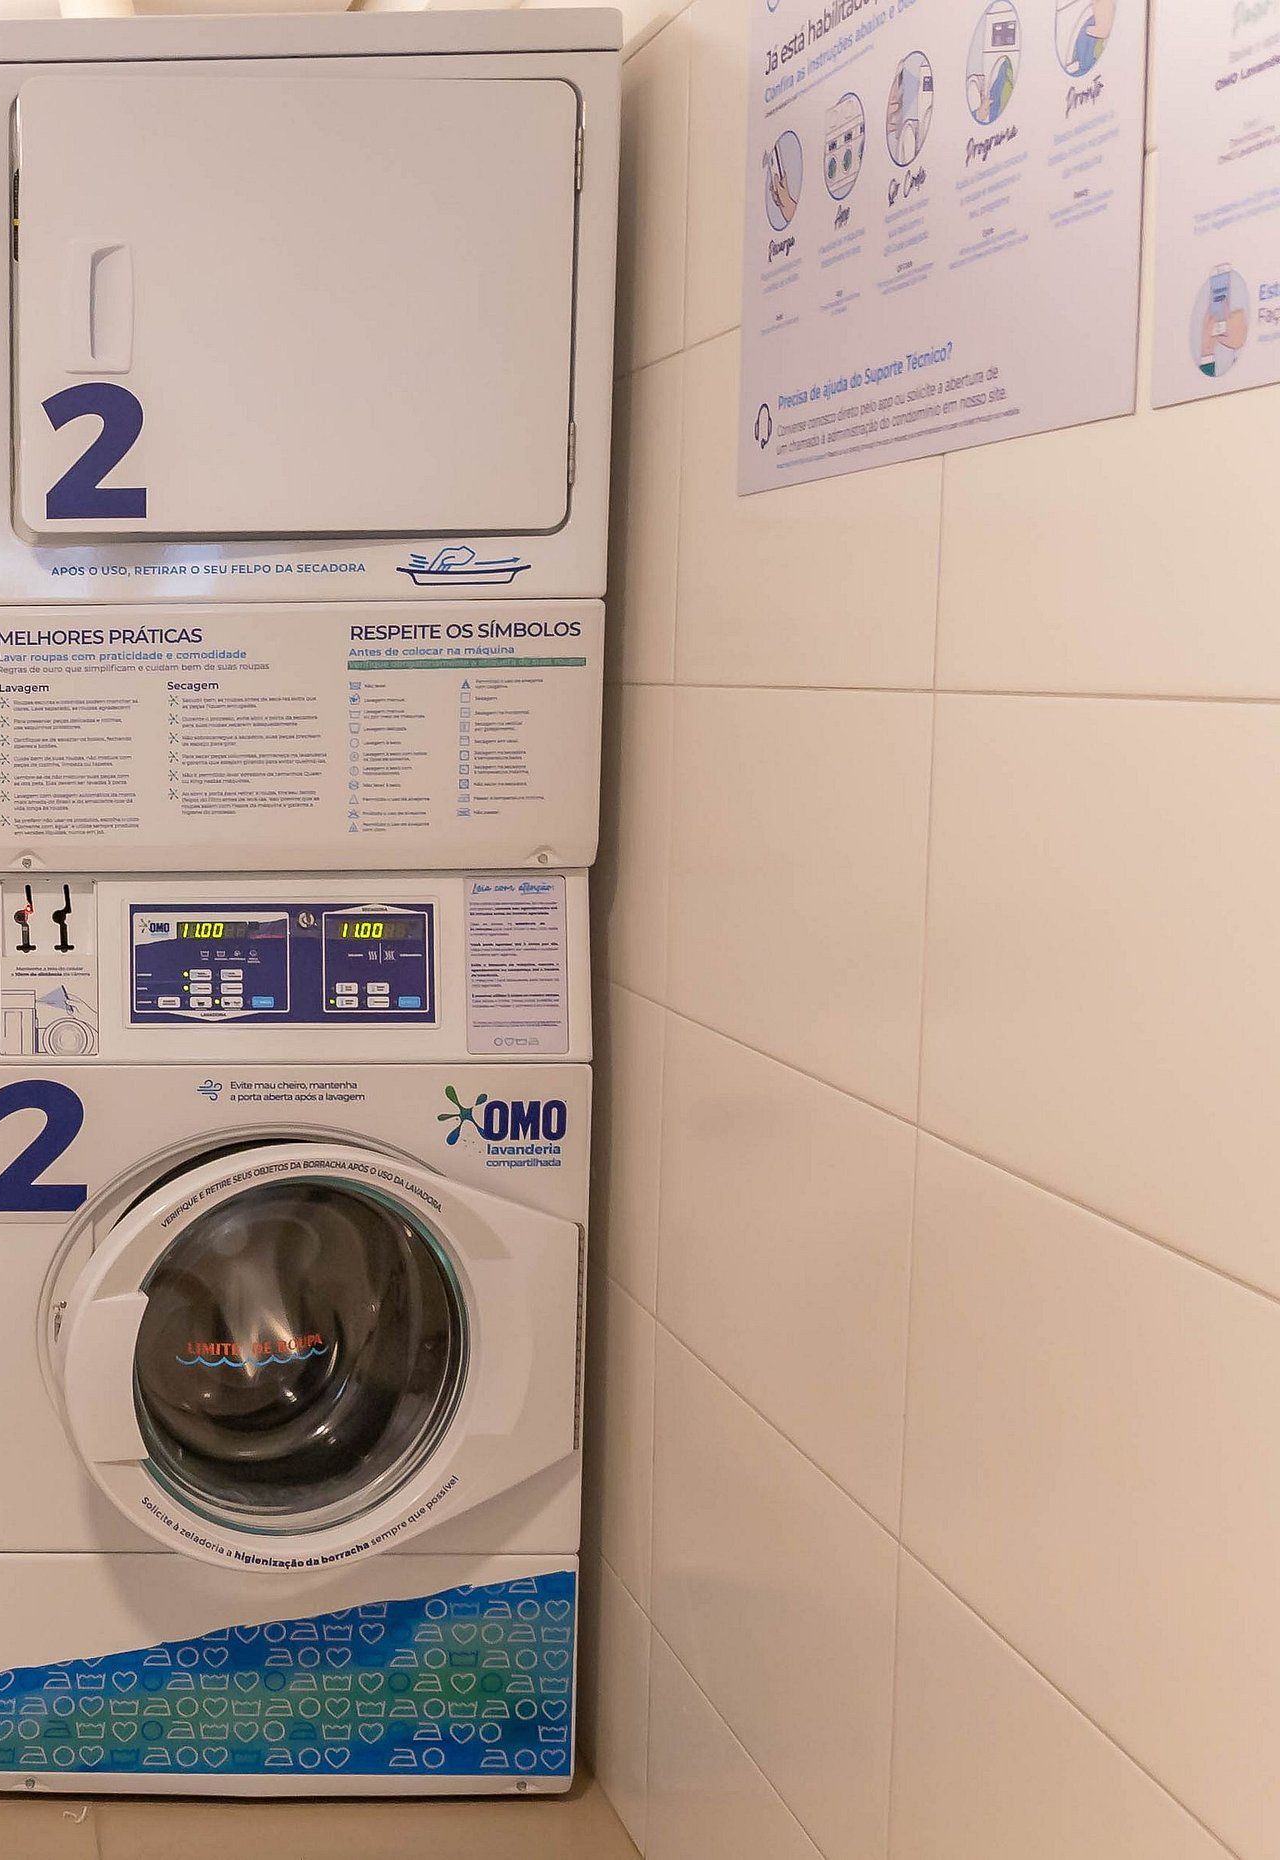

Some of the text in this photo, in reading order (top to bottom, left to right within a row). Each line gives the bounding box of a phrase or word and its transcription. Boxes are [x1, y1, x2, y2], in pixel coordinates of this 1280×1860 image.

[778, 394, 807, 410] Precisa
[810, 389, 820, 401] de
[823, 378, 848, 399] ajuda
[850, 372, 862, 389] do
[865, 360, 903, 384] Suporte
[41, 382, 147, 519] 2
[88, 566, 98, 576] O
[101, 566, 130, 577] USO,
[135, 566, 186, 575] RETIRAR
[191, 566, 200, 574] O
[204, 565, 227, 574] SEU
[232, 565, 271, 574] FELPO
[276, 564, 293, 573] DA
[297, 564, 365, 573] SECADORA
[110, 627, 202, 644] PRÁTICAS
[351, 620, 581, 640] RESPEITE OS SÍMBOLOS
[31, 654, 68, 663] roupas
[99, 651, 163, 662] praticidade
[176, 650, 247, 659] comodidade
[349, 648, 381, 656] Antes
[385, 647, 399, 656] de
[402, 647, 442, 656] colocar
[465, 645, 515, 657] máquina
[0, 684, 49, 695] Lavagem
[167, 681, 219, 692] Secagem
[471, 883, 491, 894] Leia
[150, 923, 170, 933] OMO
[183, 923, 224, 938] 11.00
[342, 923, 383, 938] 11.00
[230, 1081, 253, 1090] Evite
[277, 1081, 308, 1091] cheiro,
[309, 1081, 358, 1089] mantenha
[238, 1094, 261, 1103] porta
[263, 1093, 293, 1101] aberta
[295, 1093, 317, 1102] após
[326, 1093, 365, 1102] lavagem
[483, 1100, 566, 1141] OMO
[487, 1143, 560, 1155] lavanderia
[486, 1158, 561, 1169] compartilhada
[161, 1195, 198, 1228] VERIFIQUE
[199, 1191, 205, 1199] E
[205, 1177, 232, 1196] RETIRE
[232, 1171, 253, 1184] SEUS
[253, 1162, 289, 1177] OBJETOS
[290, 1161, 301, 1170] DA
[303, 1160, 346, 1169] BORRACHA
[348, 1162, 369, 1174] APÓS
[370, 1167, 377, 1175] O
[377, 1170, 393, 1181] USO
[394, 1176, 405, 1187] DA
[141, 1497, 173, 1526] Solicite
[173, 1522, 179, 1531] à
[180, 1528, 224, 1554] zeladoria
[234, 1551, 304, 1569] higienização
[306, 1557, 320, 1567] da
[321, 1541, 370, 1564] borracha
[371, 1520, 407, 1546] sempre
[407, 1507, 426, 1523] que
[426, 1474, 459, 1511] possível
